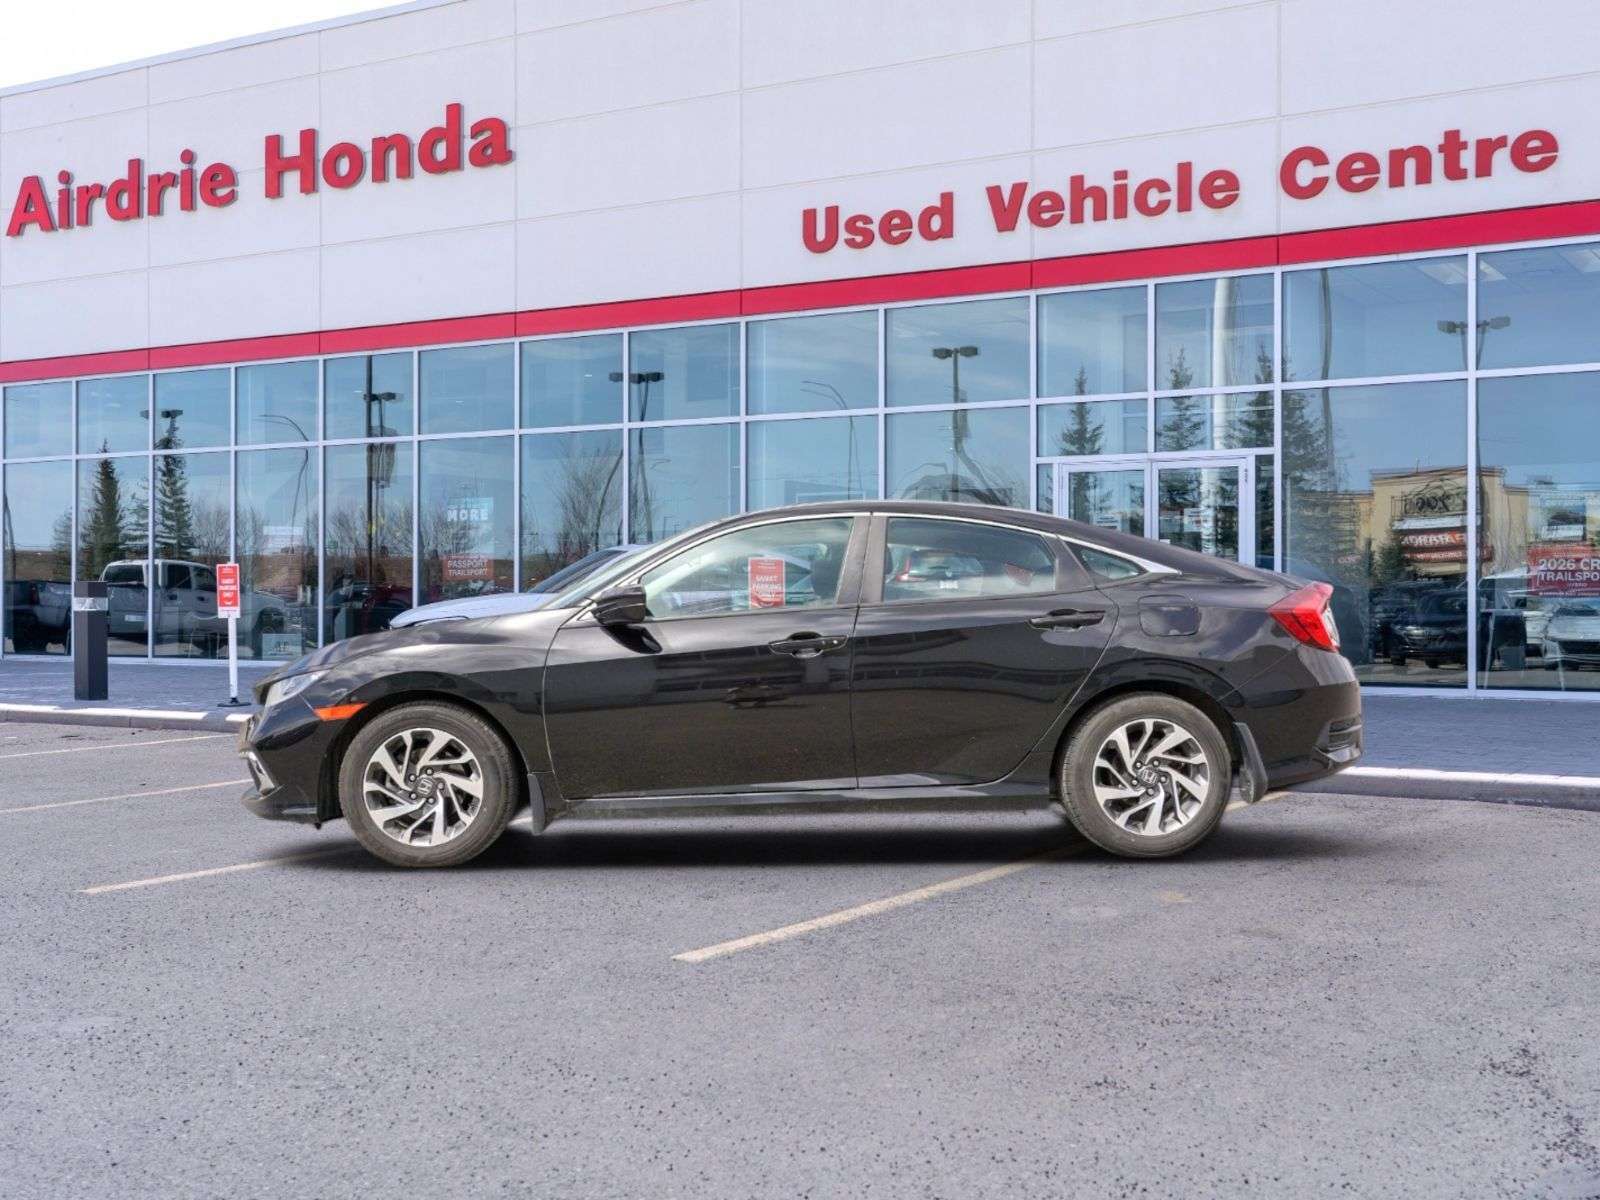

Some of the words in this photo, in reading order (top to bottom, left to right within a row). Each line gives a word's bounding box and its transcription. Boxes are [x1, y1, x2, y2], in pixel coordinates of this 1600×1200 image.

[7, 150, 237, 238] Airdrie
[264, 102, 514, 198] Honda
[802, 192, 954, 253] Used
[986, 161, 1240, 232] Vehicle
[1280, 129, 1559, 199] Centre
[447, 509, 489, 521] MORE
[1539, 558, 1576, 570] 2026
